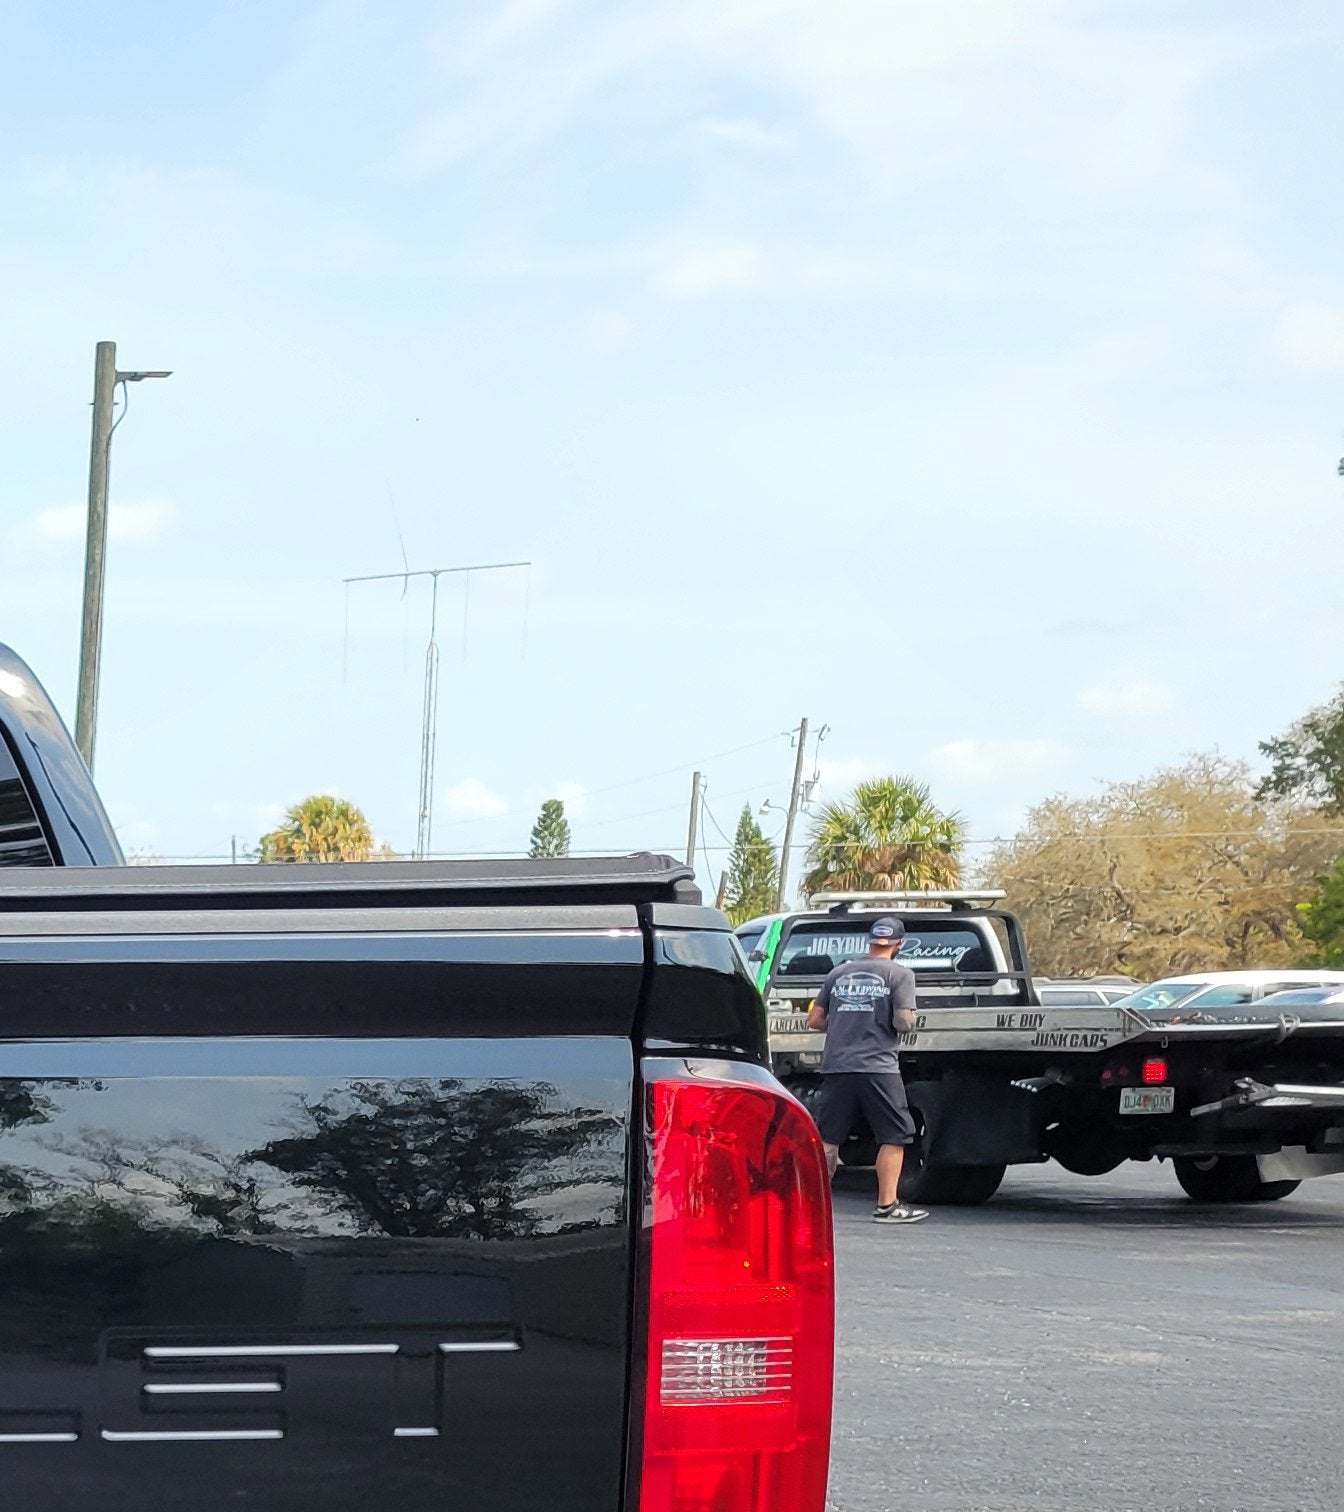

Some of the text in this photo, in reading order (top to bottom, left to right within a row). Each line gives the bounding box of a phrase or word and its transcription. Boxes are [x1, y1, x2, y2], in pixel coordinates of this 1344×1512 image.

[806, 936, 971, 972] JOEYBU Racing
[996, 1013, 1046, 1028] WE BUY
[1031, 1033, 1108, 1048] JUNK CARS
